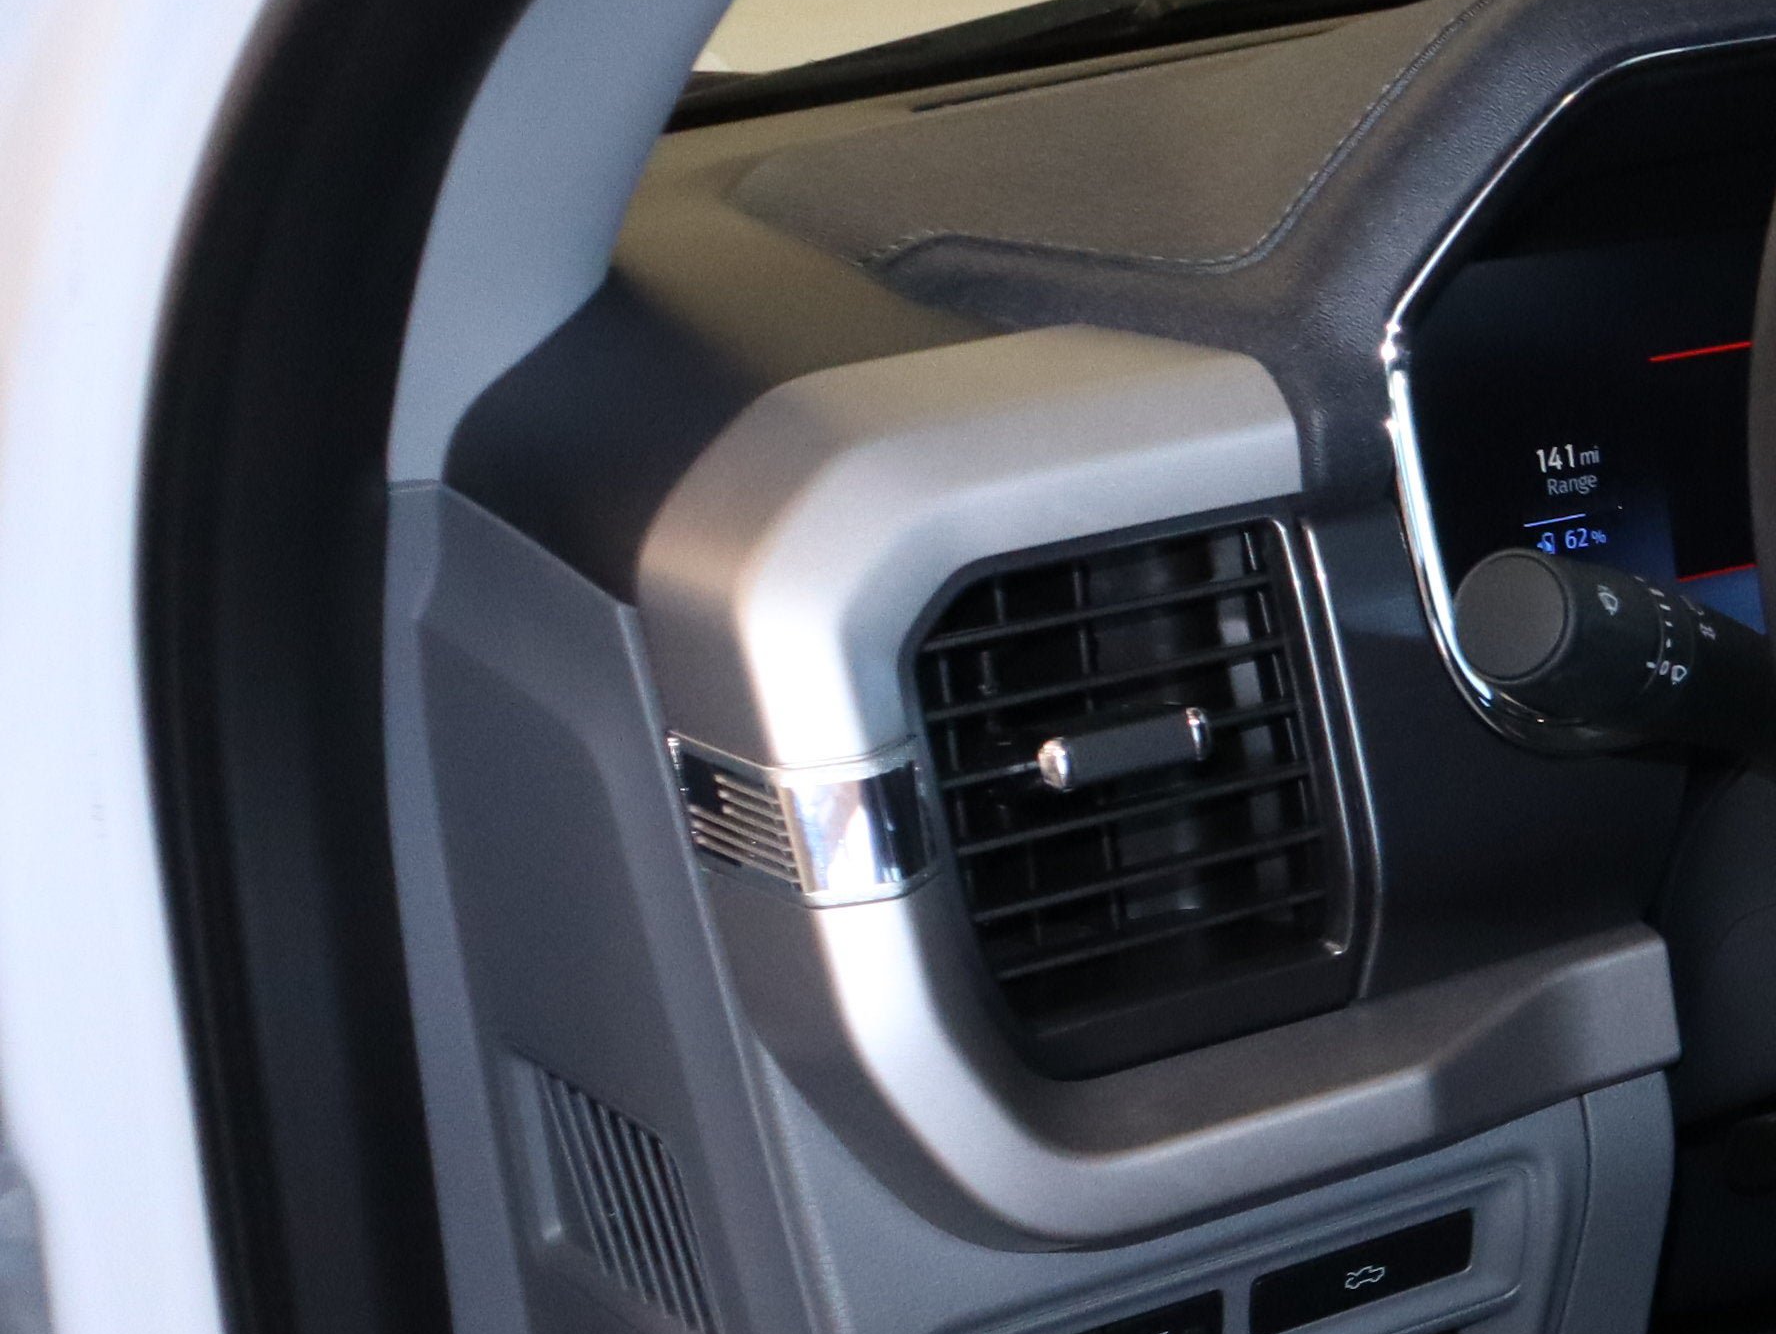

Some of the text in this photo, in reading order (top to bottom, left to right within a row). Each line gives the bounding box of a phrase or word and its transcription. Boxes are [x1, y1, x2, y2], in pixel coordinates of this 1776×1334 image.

[1536, 443, 1601, 473] 141 mi
[1546, 474, 1598, 496] Range
